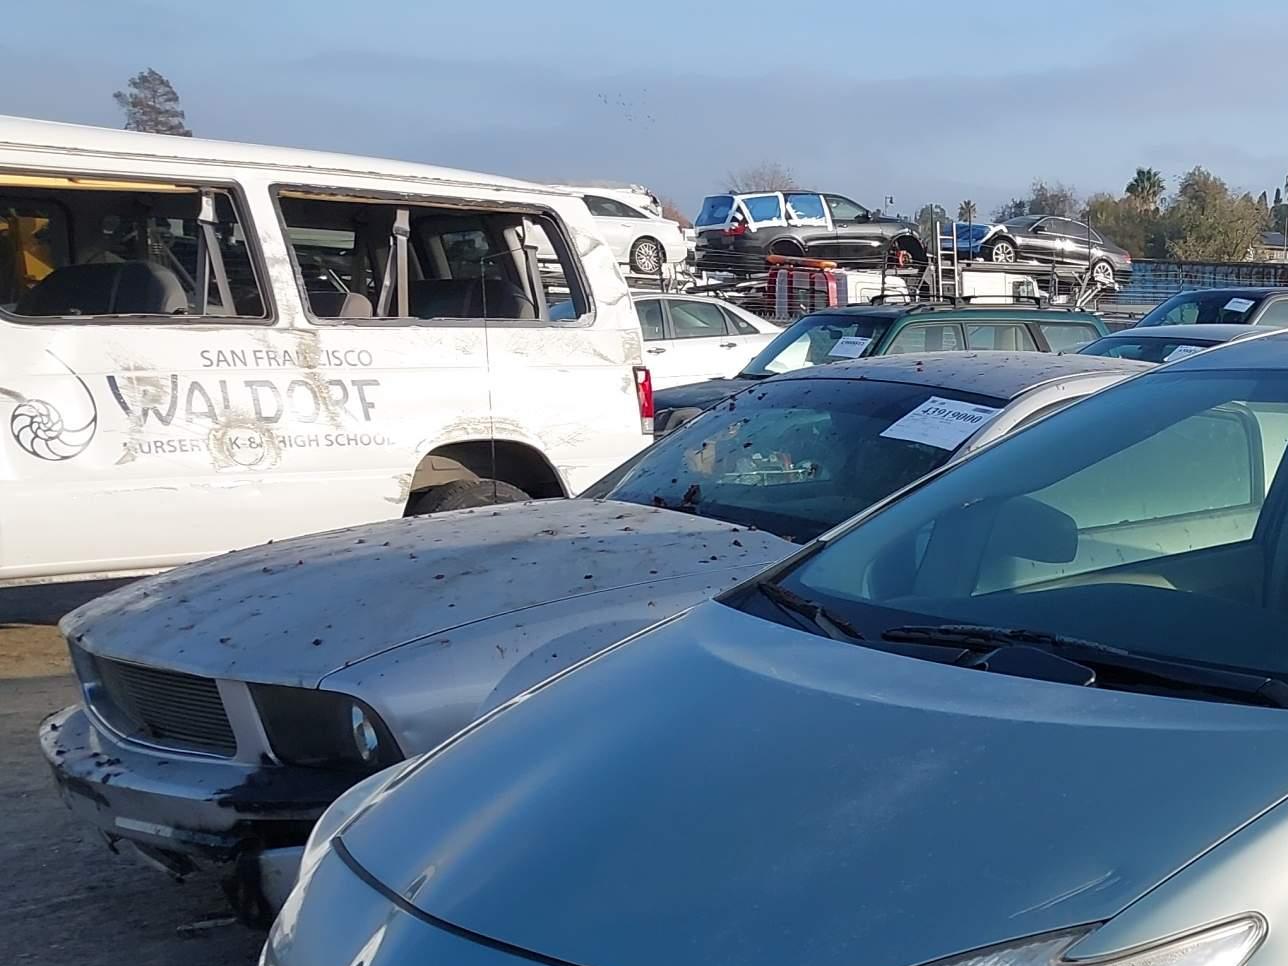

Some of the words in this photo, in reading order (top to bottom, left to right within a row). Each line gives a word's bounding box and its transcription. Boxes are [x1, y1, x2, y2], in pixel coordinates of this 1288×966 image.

[200, 349, 248, 368] SAN
[253, 349, 373, 368] FRAISCO
[122, 439, 209, 455] URSER
[324, 433, 396, 447] SCHOOL
